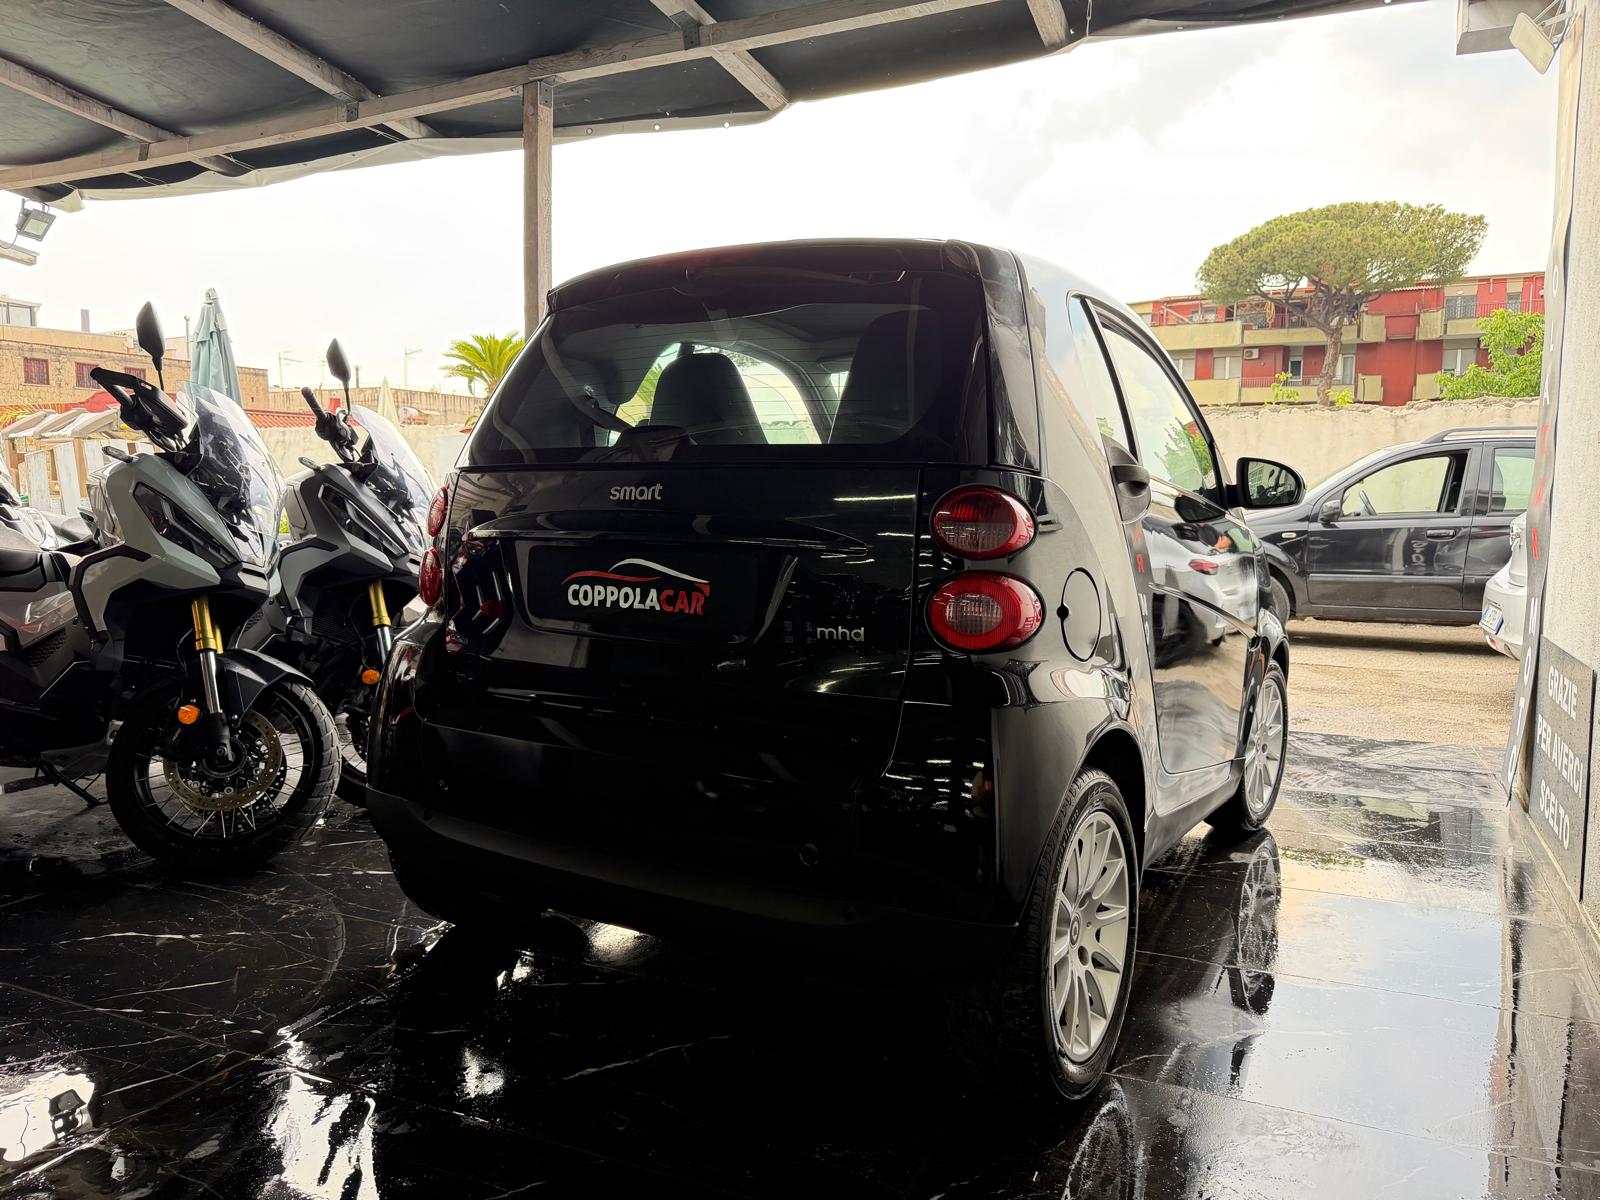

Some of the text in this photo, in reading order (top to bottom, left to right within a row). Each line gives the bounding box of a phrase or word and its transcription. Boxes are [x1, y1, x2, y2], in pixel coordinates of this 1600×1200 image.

[609, 483, 663, 501] smart
[816, 625, 866, 642] mhd
[1507, 597, 1539, 784] MOTO
[1548, 665, 1578, 720] GRAZIE
[1536, 713, 1584, 798] PER AVERCI
[1539, 778, 1570, 850] SCELTO
